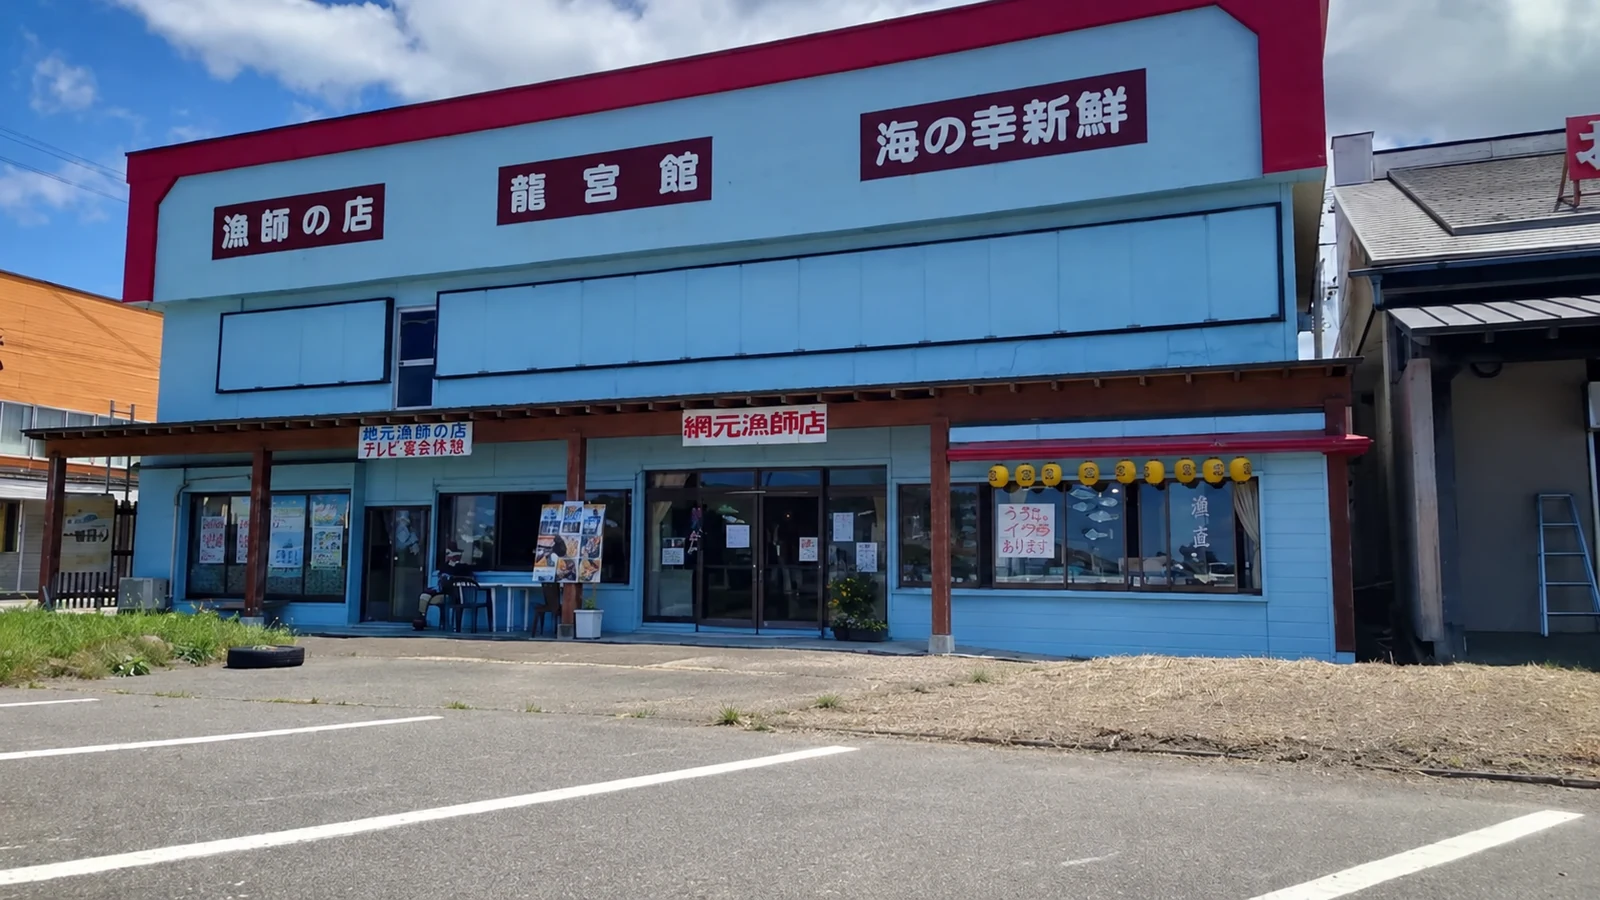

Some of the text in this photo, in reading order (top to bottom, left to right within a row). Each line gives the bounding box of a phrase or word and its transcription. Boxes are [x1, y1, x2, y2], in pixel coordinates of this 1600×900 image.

[875, 85, 1128, 167] 海の幸新鮮
[510, 151, 699, 213] 龍宮館
[221, 195, 374, 249] 漁師の店
[362, 422, 467, 441] 地元漁師の店
[683, 410, 826, 439] 網元漁師店
